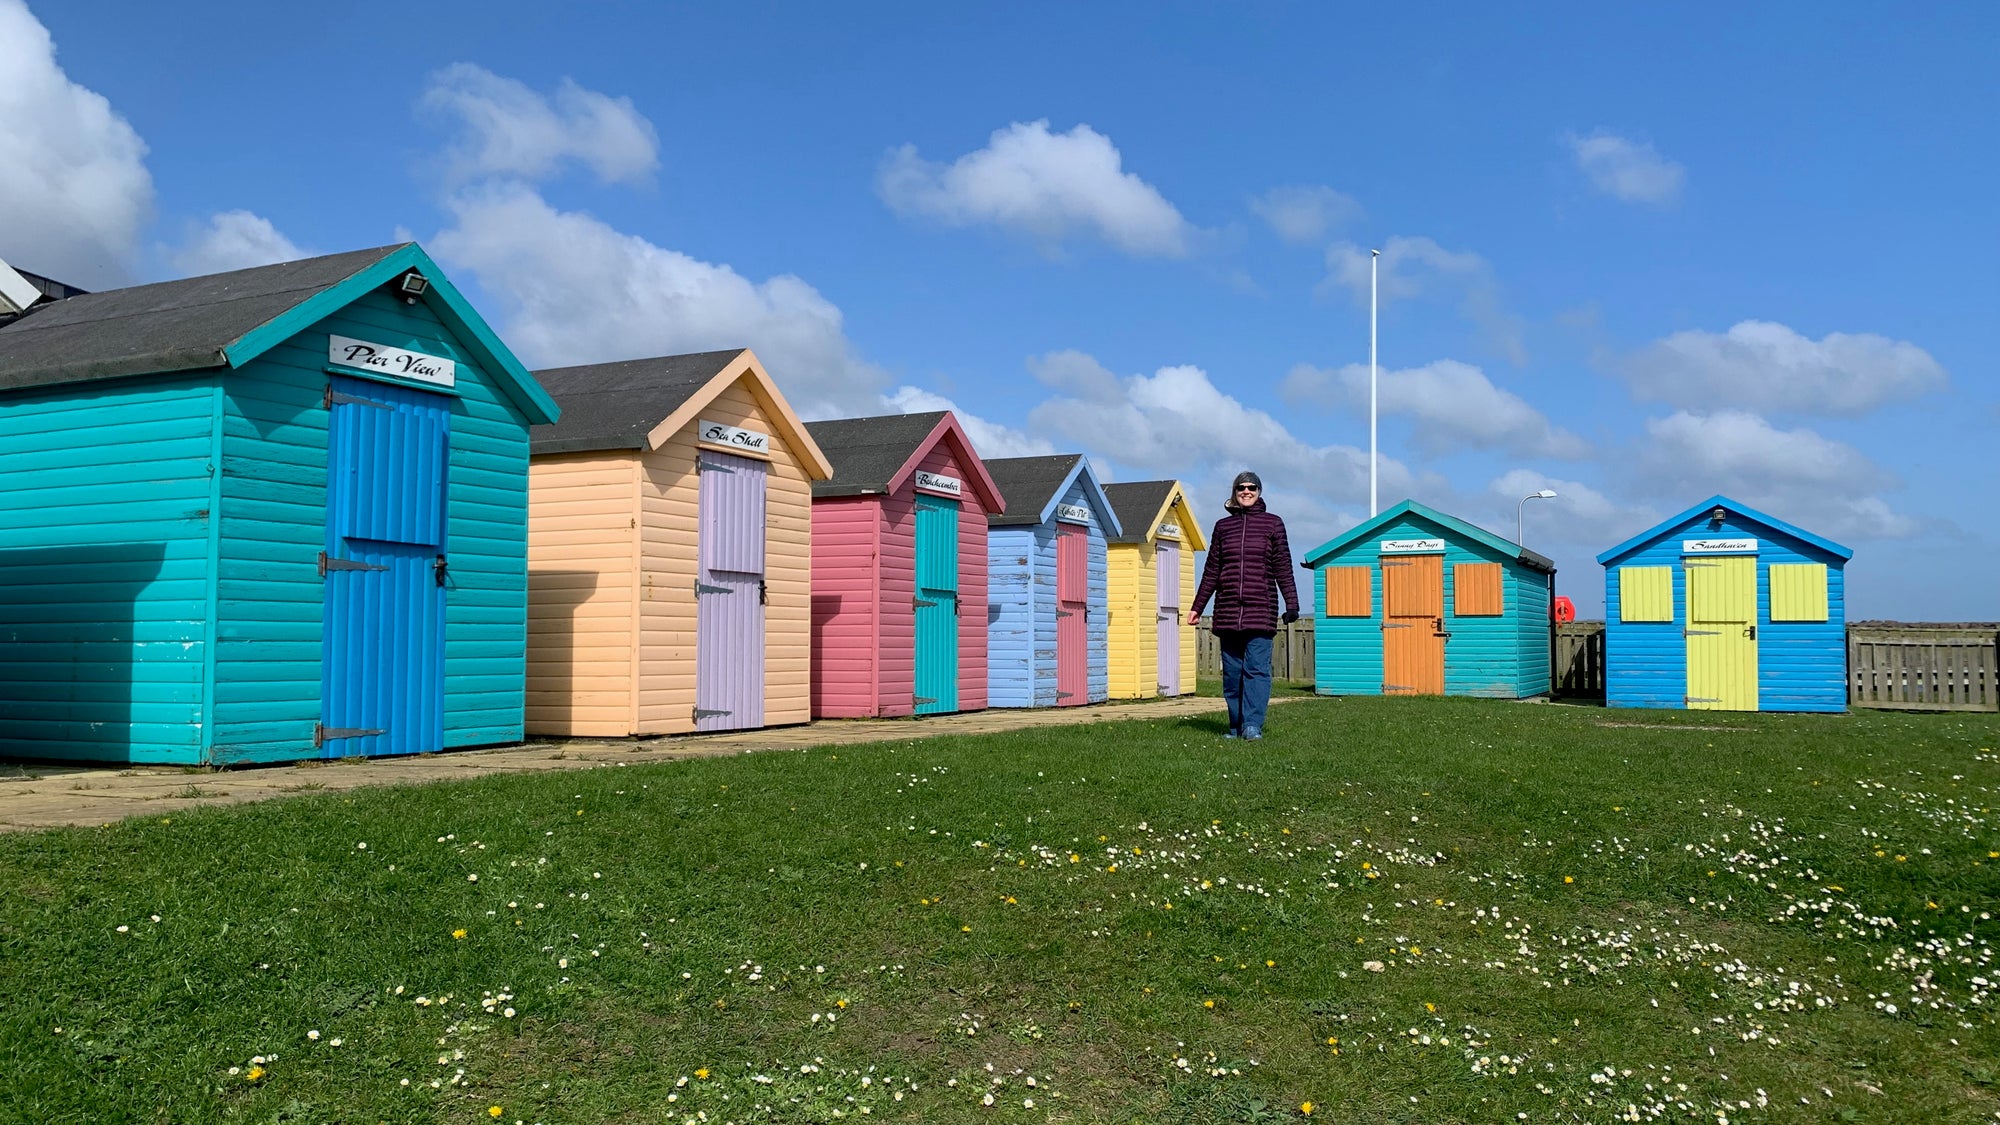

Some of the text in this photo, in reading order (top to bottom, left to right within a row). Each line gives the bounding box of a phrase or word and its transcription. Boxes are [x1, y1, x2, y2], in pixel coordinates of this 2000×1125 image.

[344, 344, 442, 377] Pier View
[705, 426, 763, 448] Sea Shell
[918, 474, 958, 490] Beachcomber
[1385, 540, 1439, 549] Sunny Days
[1691, 541, 1747, 550] Sandhaven
